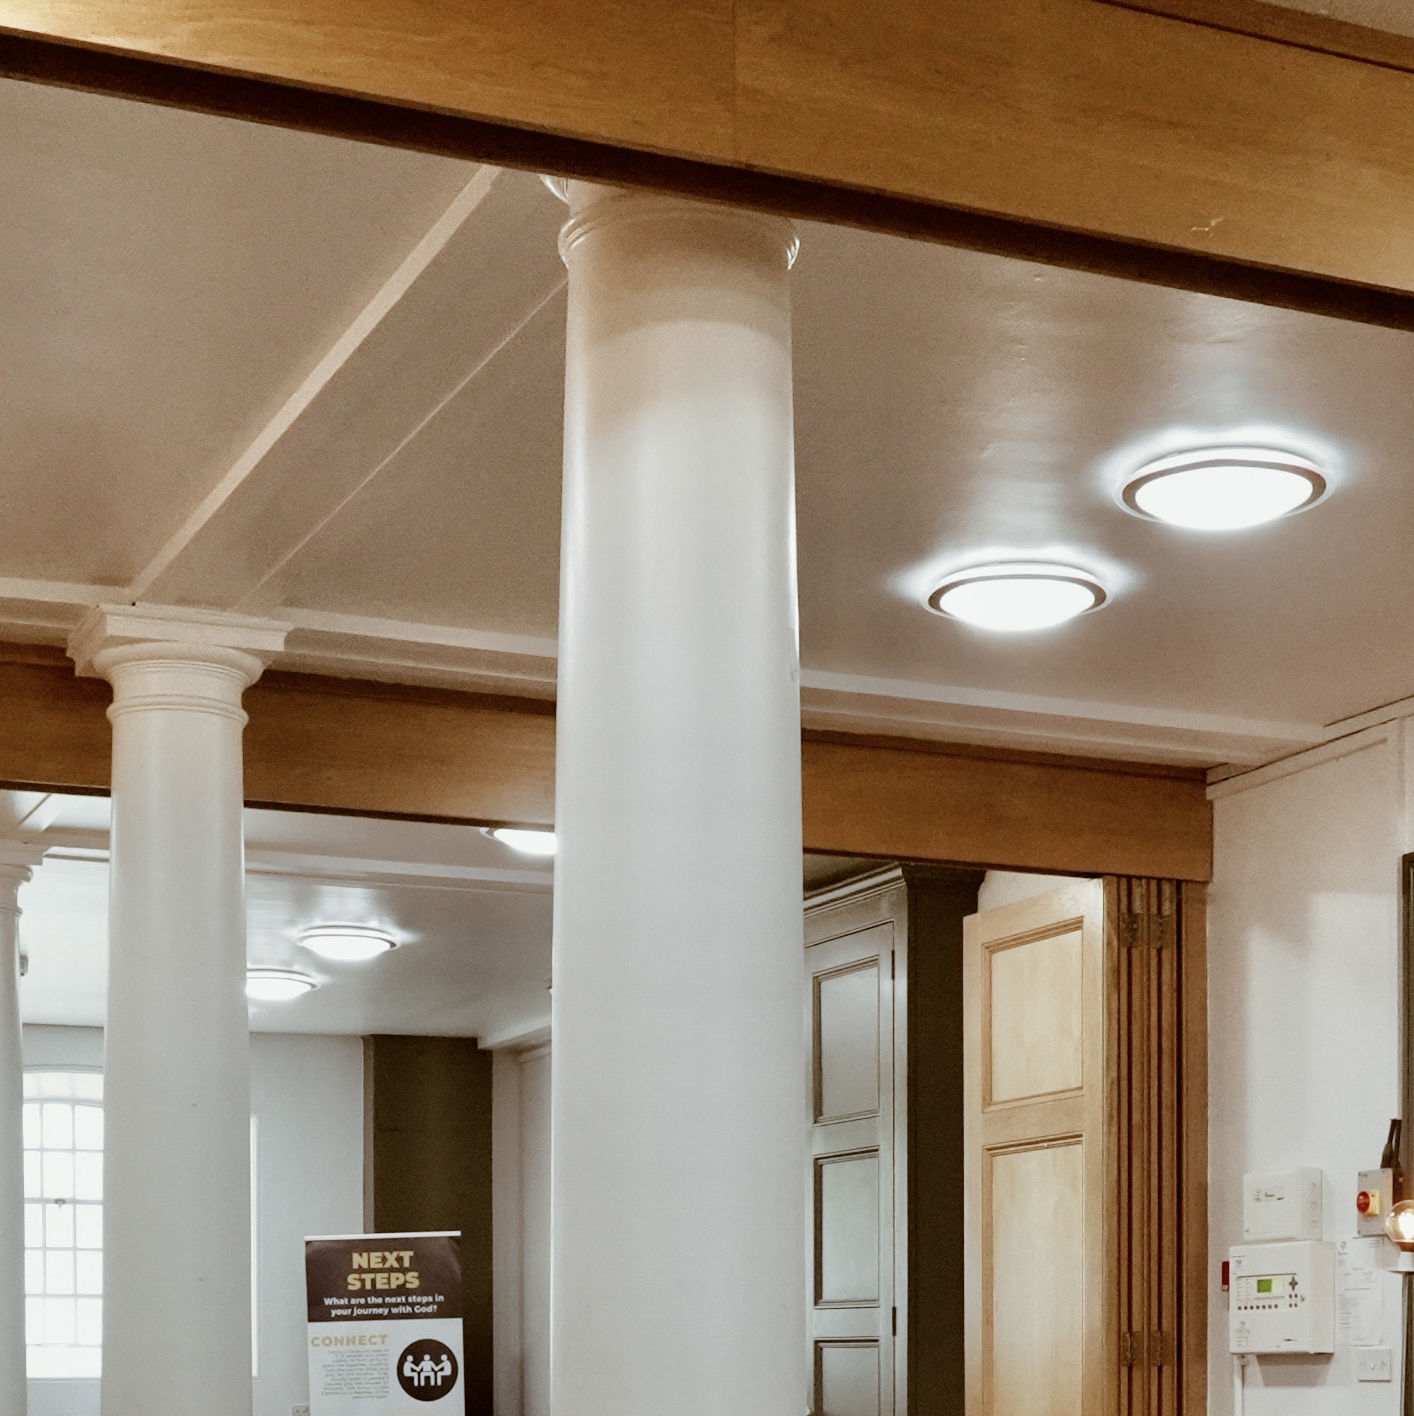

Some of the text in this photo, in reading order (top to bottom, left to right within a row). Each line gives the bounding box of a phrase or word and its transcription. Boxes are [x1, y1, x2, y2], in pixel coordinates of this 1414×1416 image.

[352, 1250, 414, 1269] NEXT
[346, 1272, 420, 1291] STEPS
[323, 1297, 350, 1306] What
[367, 1296, 383, 1304] the
[384, 1296, 407, 1304] next
[408, 1295, 434, 1304] steps
[435, 1293, 445, 1302] in
[330, 1304, 439, 1318] your journey with God?
[311, 1334, 388, 1347] CONNECT
